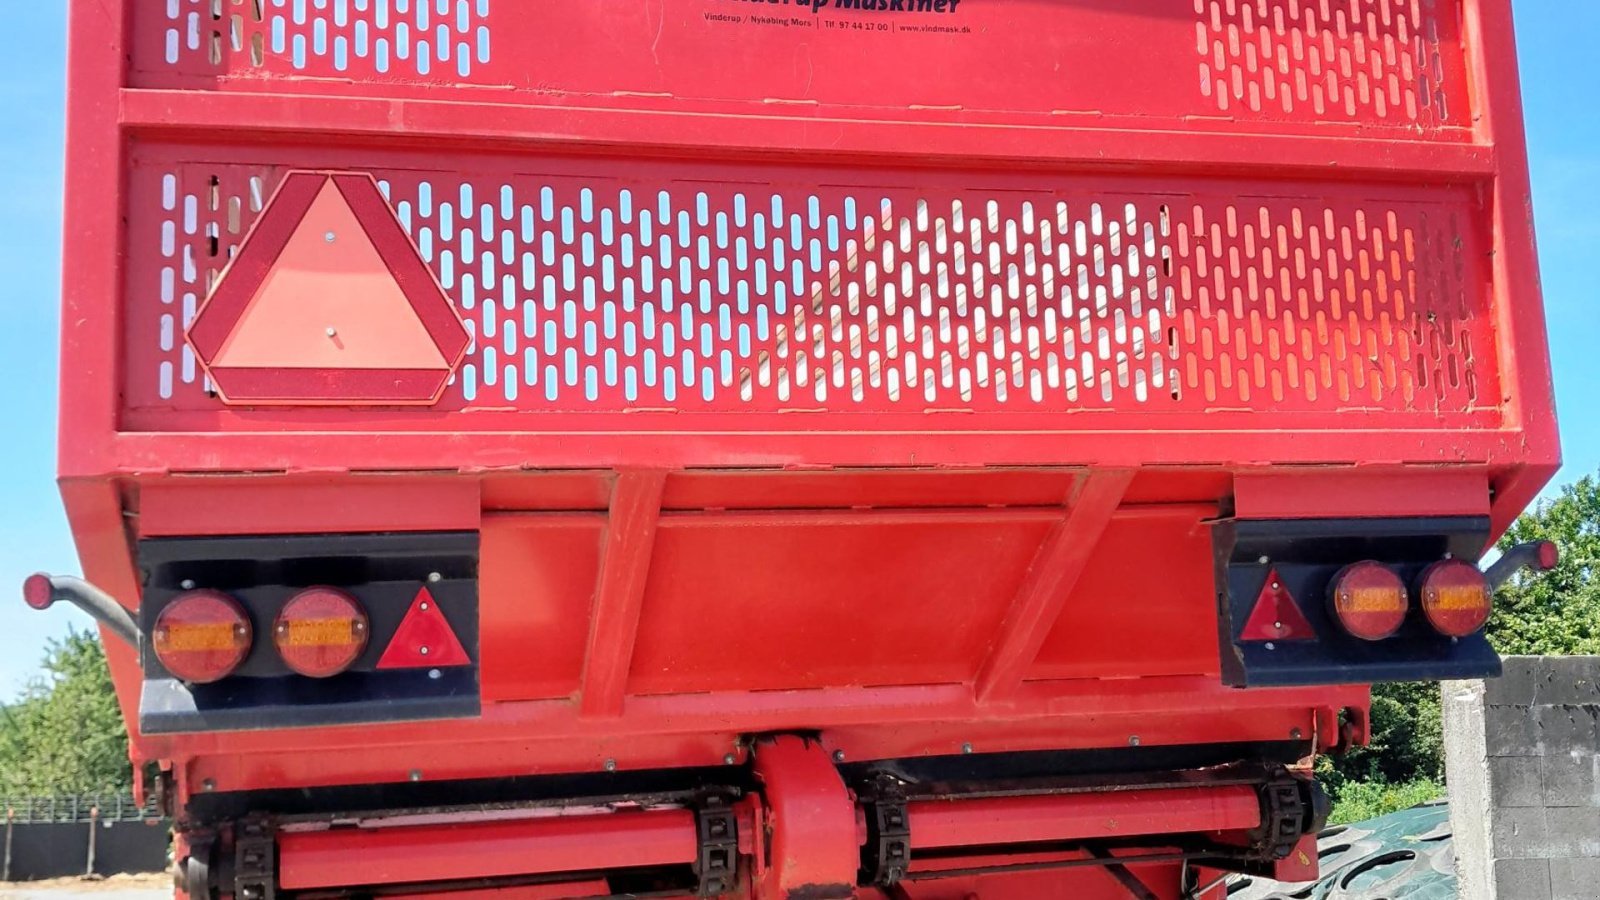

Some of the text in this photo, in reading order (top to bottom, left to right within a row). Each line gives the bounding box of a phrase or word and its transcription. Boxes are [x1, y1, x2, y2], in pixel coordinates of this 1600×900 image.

[704, 12, 741, 23] Vinderup
[791, 18, 812, 27] Mors
[839, 21, 849, 29] 97
[852, 22, 863, 30] 44
[865, 22, 875, 30] 17
[877, 23, 888, 31] 00
[899, 24, 971, 33] www.vindmask.dk
